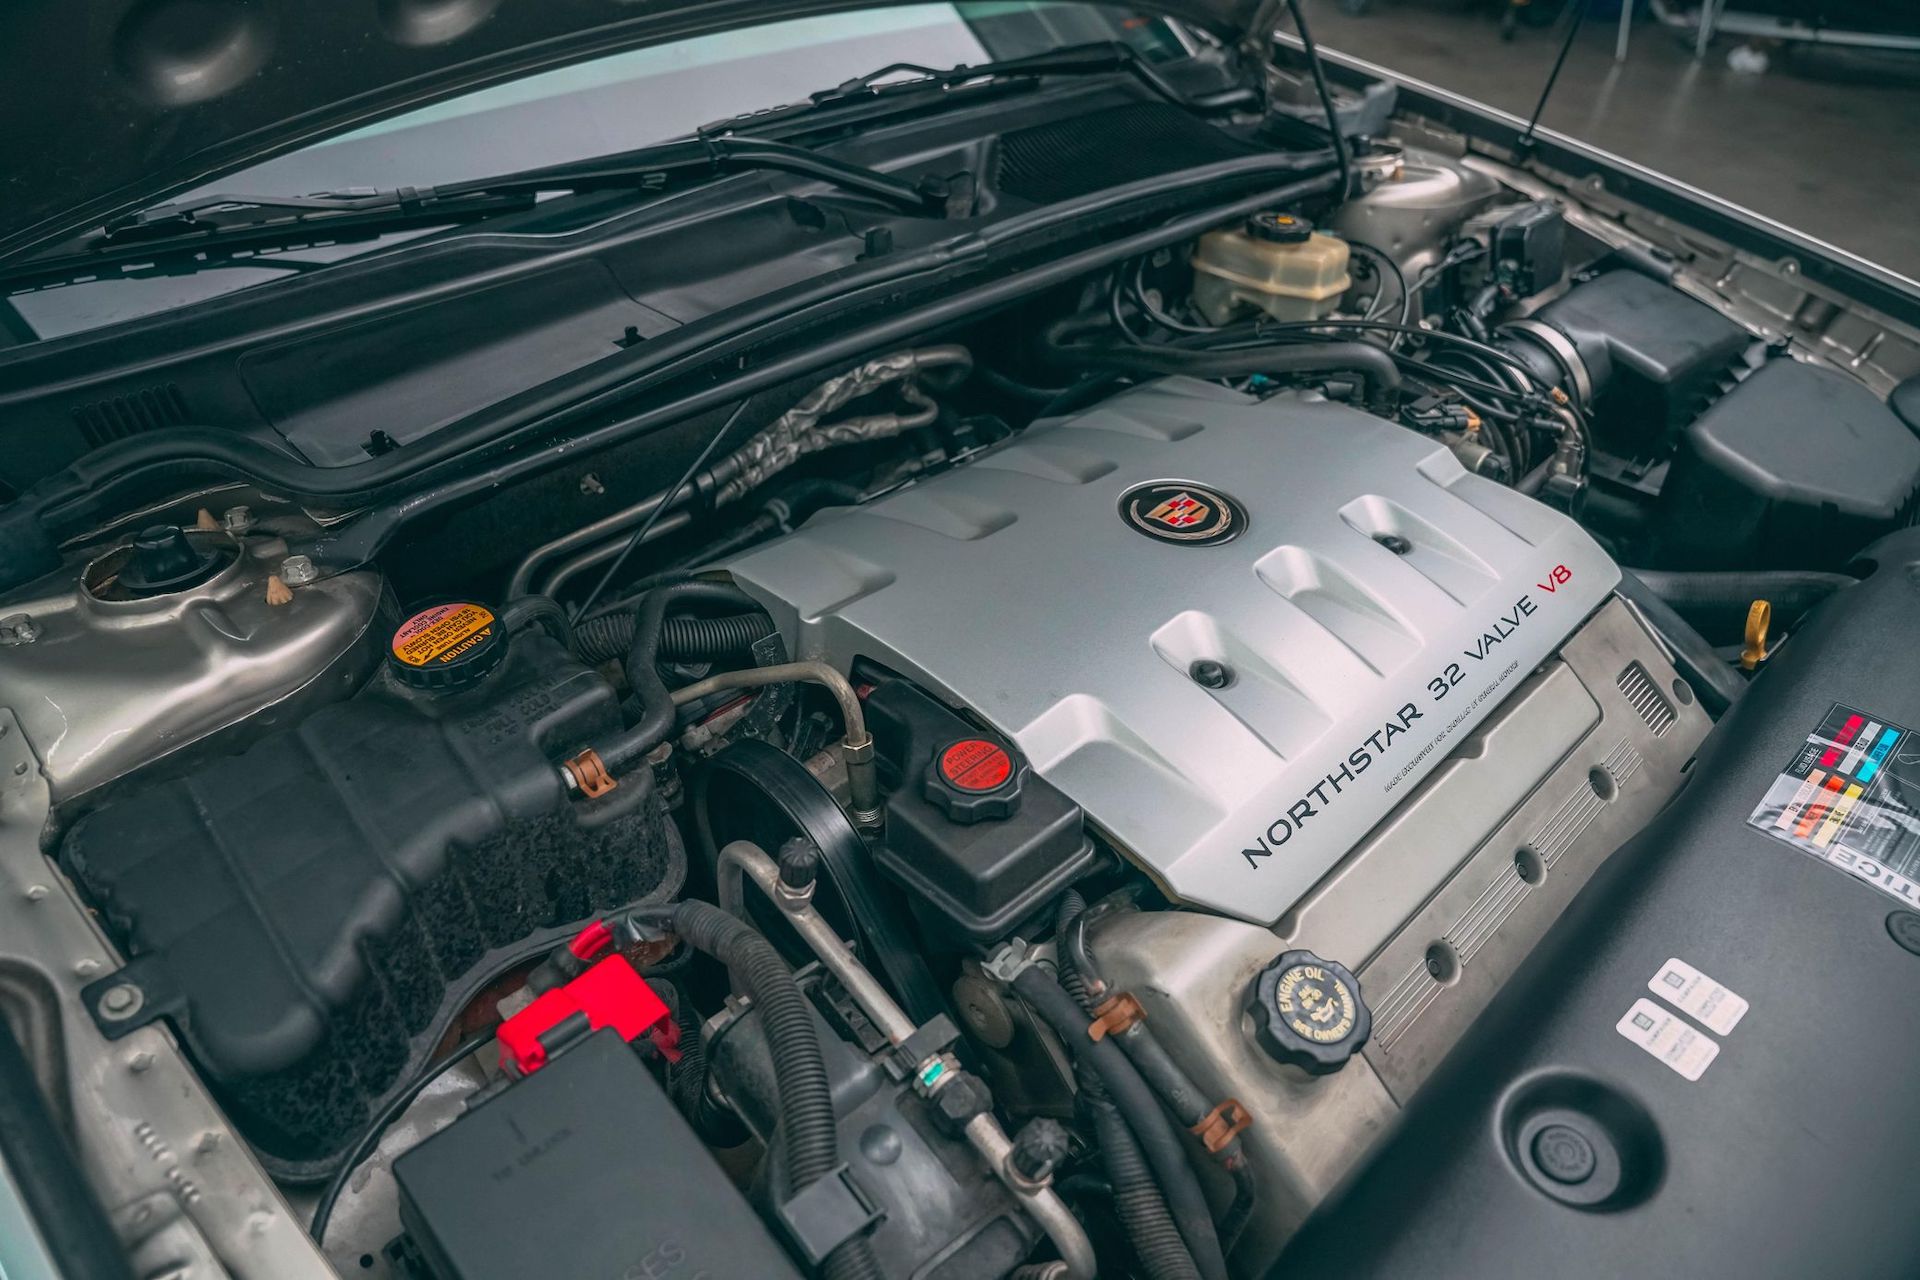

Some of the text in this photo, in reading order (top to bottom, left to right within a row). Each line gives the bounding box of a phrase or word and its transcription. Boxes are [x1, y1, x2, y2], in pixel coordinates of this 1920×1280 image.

[430, 620, 451, 634] OPEN
[447, 619, 462, 630] CAN
[461, 610, 478, 622] YOU
[403, 632, 431, 651] SLOWLY
[406, 635, 436, 655] BURNED
[417, 616, 477, 655] NEVER OPEN HOT
[440, 634, 484, 663] CAUTION
[1241, 564, 1573, 870] NORTHSTAR 32 VALVE V8
[946, 742, 977, 765] POWER
[949, 745, 993, 776] STEERING
[1835, 848, 1920, 905] TICE
[1279, 968, 1305, 1013] ENGINE
[1304, 966, 1325, 982] OIL
[1292, 1018, 1314, 1039] SEE
